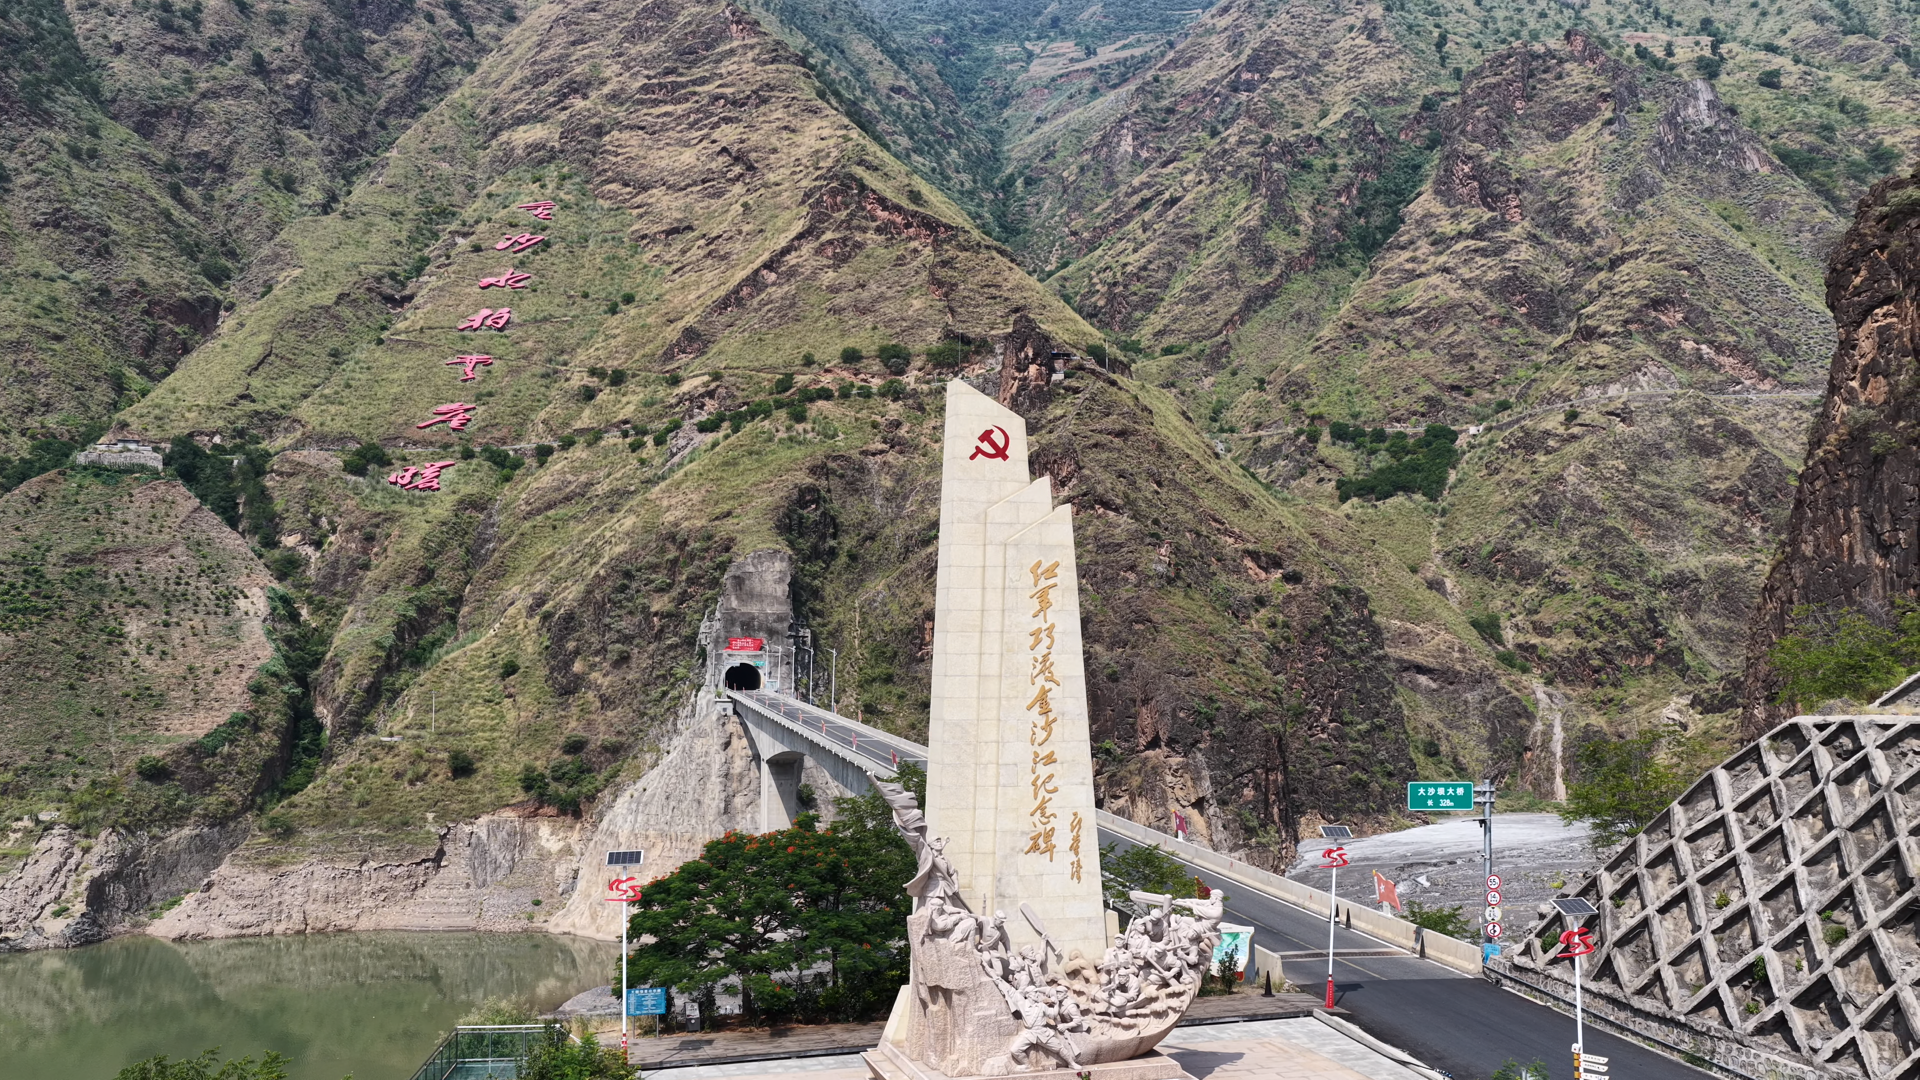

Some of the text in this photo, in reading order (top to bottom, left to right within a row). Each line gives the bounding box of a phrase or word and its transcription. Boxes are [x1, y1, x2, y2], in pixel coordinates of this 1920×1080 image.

[1025, 559, 1061, 862] 红军巧渡金沙江纪念碑
[1418, 787, 1464, 796] 大沙坝大桥
